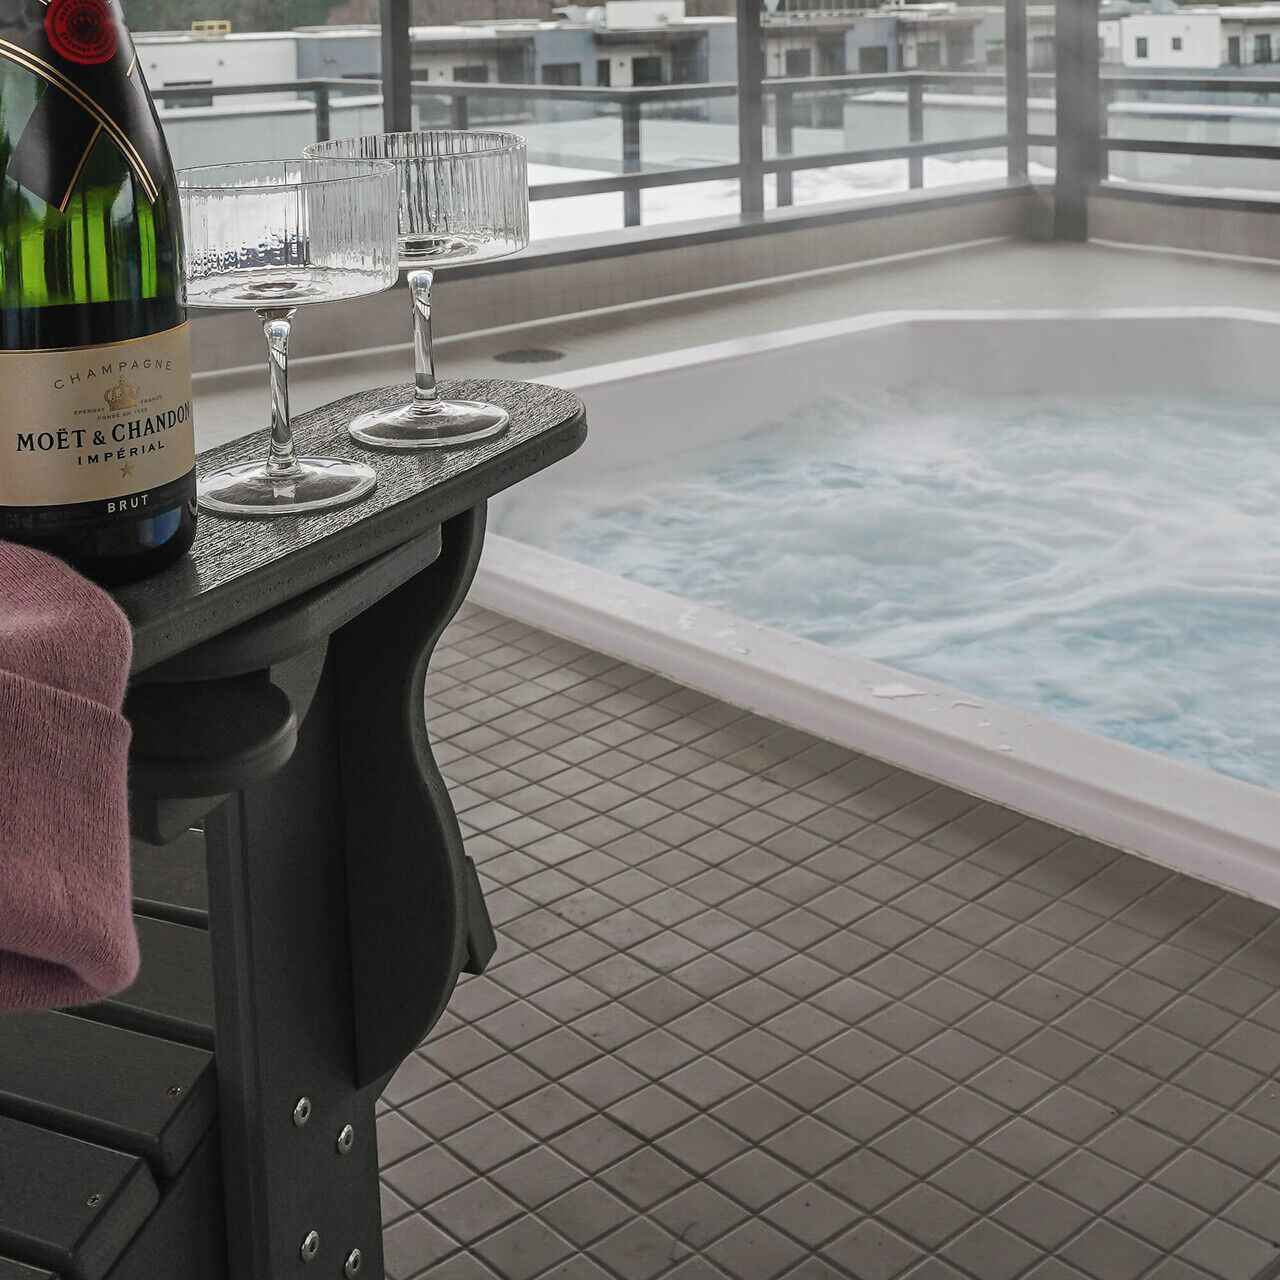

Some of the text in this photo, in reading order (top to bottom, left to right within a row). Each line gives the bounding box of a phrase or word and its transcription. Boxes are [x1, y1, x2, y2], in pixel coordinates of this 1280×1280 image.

[54, 359, 172, 390] CHAMPAGNE
[16, 400, 191, 452] MOËT & CHANDON
[77, 440, 165, 465] IMPÉRIAL
[107, 494, 149, 514] BRUT
